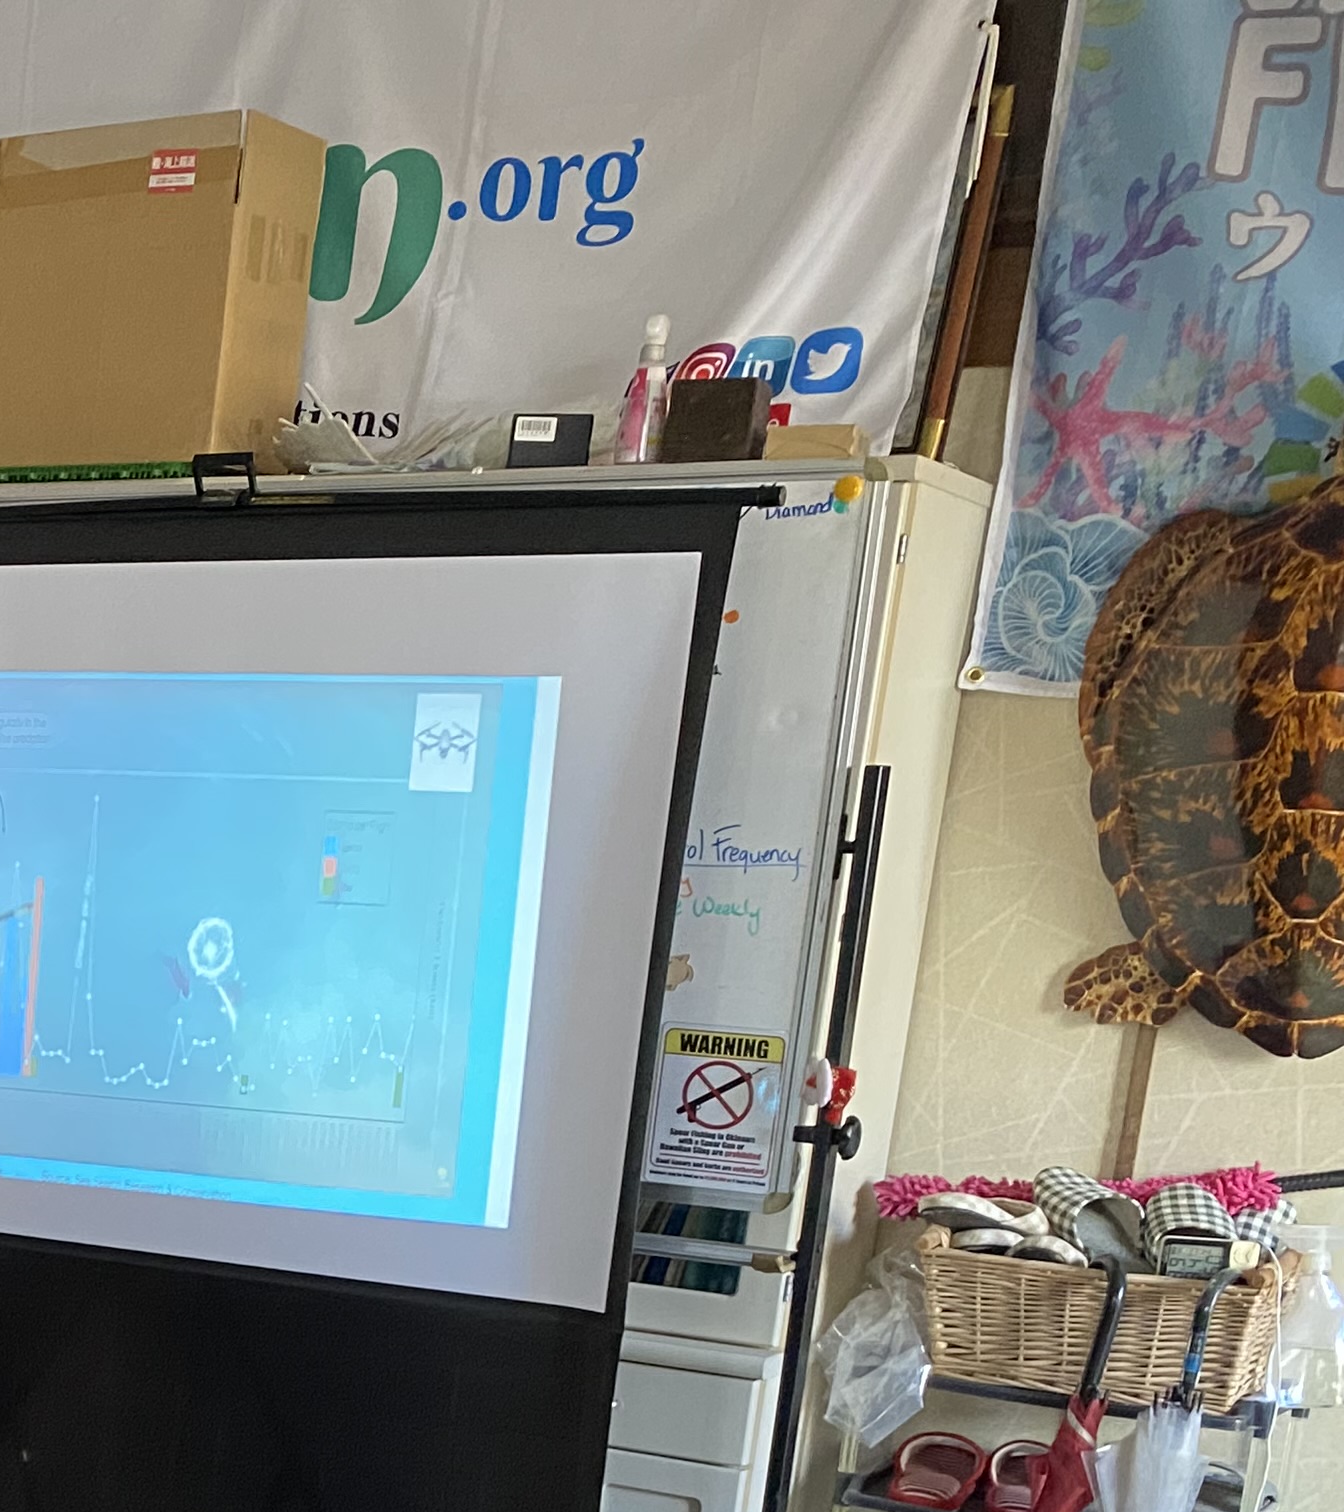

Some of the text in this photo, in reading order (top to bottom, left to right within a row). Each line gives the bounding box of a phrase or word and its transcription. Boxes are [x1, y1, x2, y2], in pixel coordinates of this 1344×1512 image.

[1227, 190, 1313, 283] ウ
[712, 824, 801, 881] Frequency
[693, 897, 760, 936] Weekly
[680, 1033, 769, 1058] WARNING
